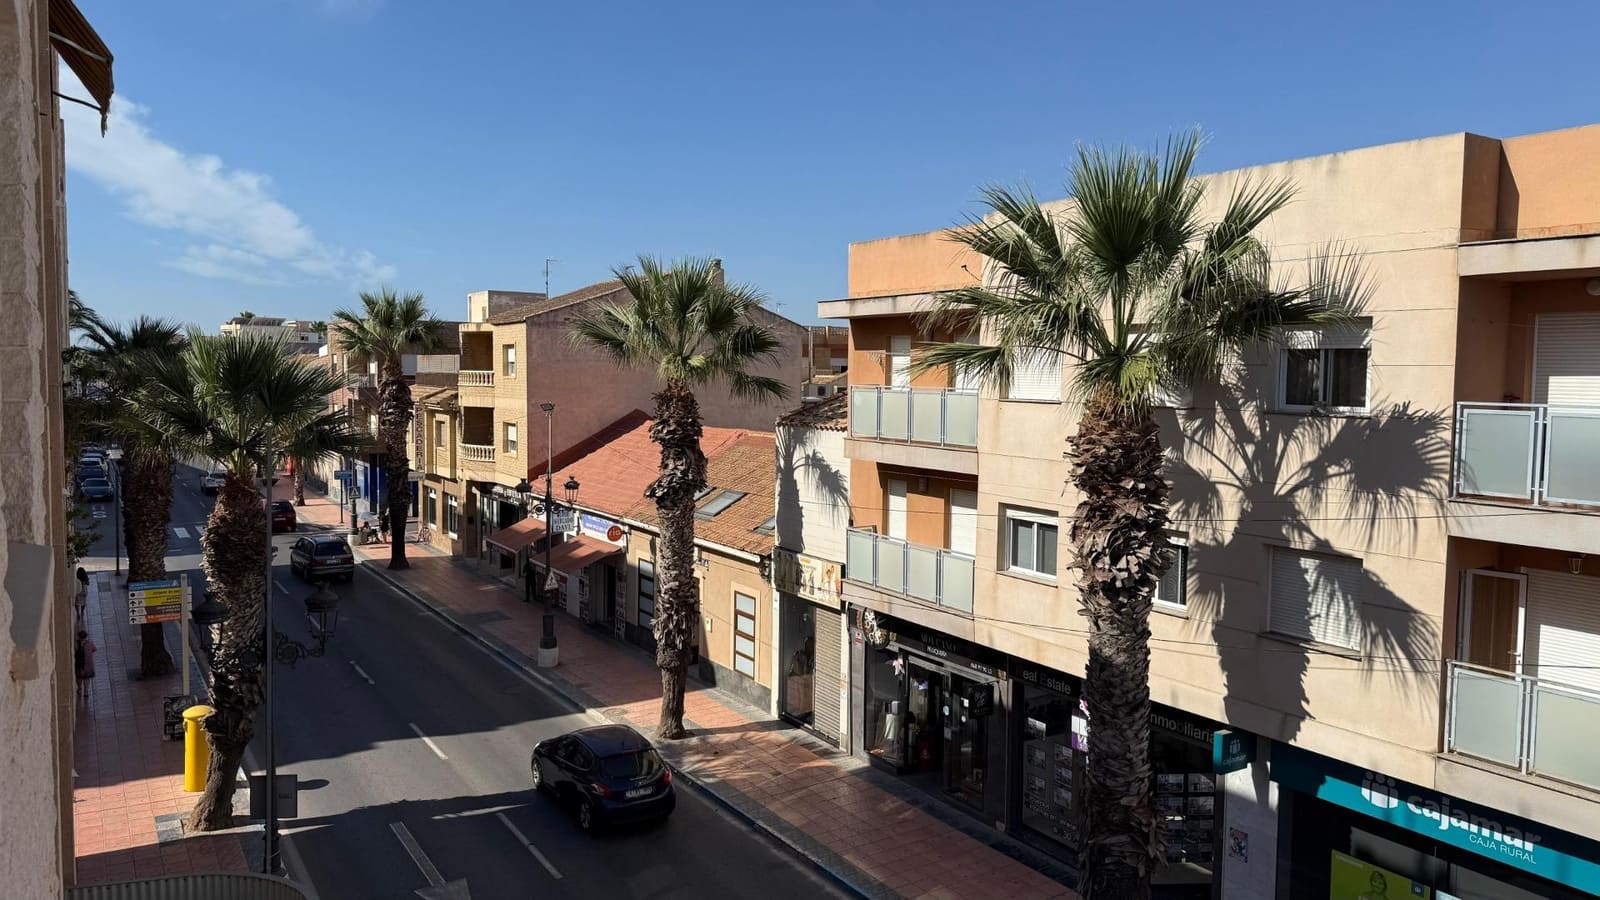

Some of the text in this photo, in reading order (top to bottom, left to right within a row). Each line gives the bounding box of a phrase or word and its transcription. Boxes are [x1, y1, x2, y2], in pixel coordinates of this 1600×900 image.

[1149, 712, 1214, 745] nmobiliaria
[1406, 794, 1542, 852] cajamar
[1468, 834, 1537, 865] CAJA RURAL
